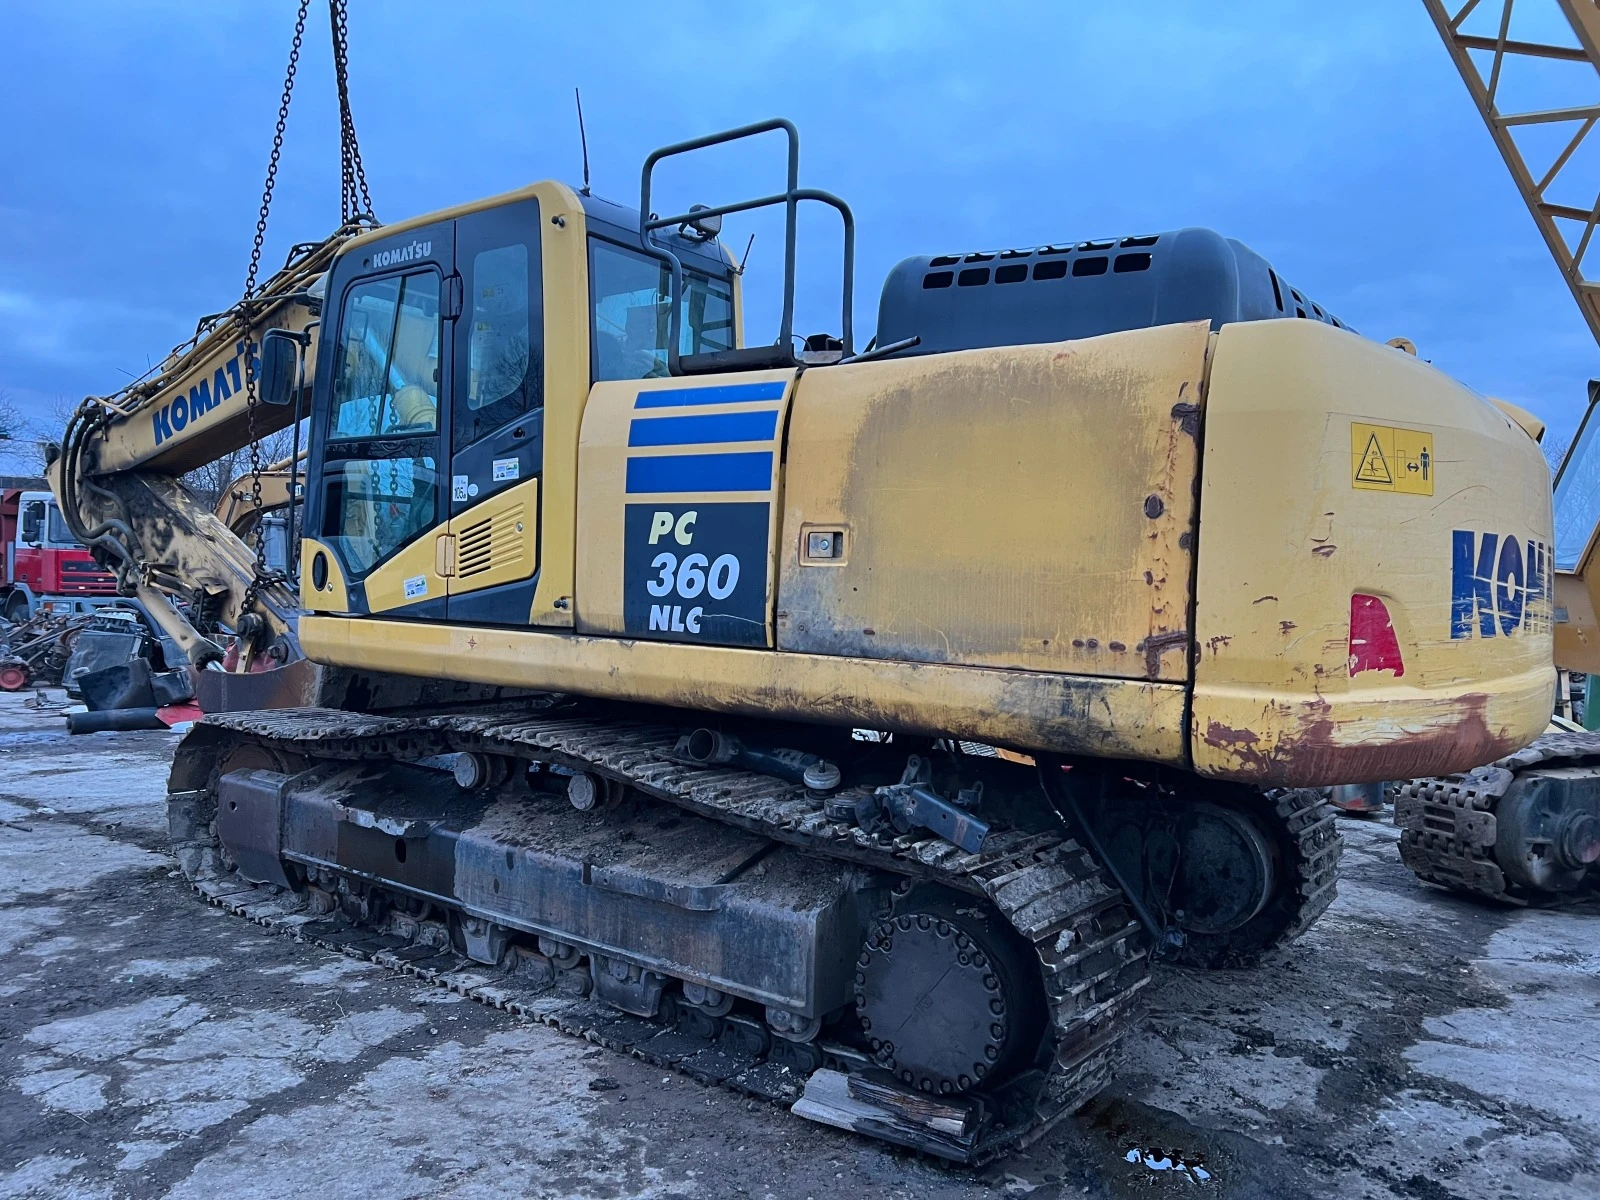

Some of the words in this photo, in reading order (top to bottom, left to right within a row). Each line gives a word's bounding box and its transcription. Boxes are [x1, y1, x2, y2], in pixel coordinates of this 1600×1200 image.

[373, 240, 432, 268] KOMATSU
[152, 340, 262, 447] KOMATS
[648, 510, 698, 546] PC
[646, 552, 740, 600] 360
[648, 604, 704, 634] NLC
